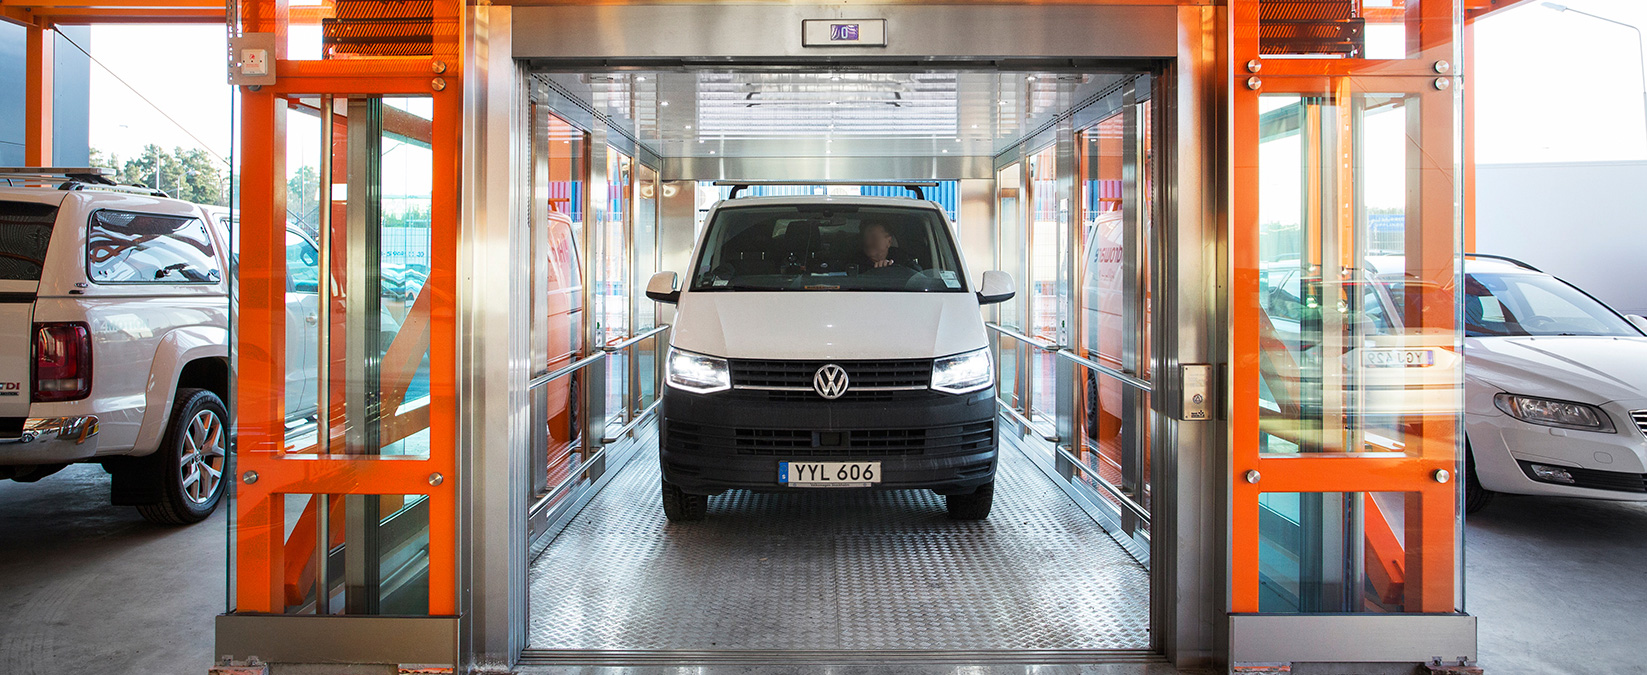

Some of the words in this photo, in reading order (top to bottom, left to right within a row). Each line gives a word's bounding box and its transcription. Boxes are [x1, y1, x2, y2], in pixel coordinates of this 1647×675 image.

[841, 26, 848, 38] 0
[100, 318, 149, 333] 4MOTION
[795, 464, 830, 481] YYL
[837, 464, 874, 481] 606
